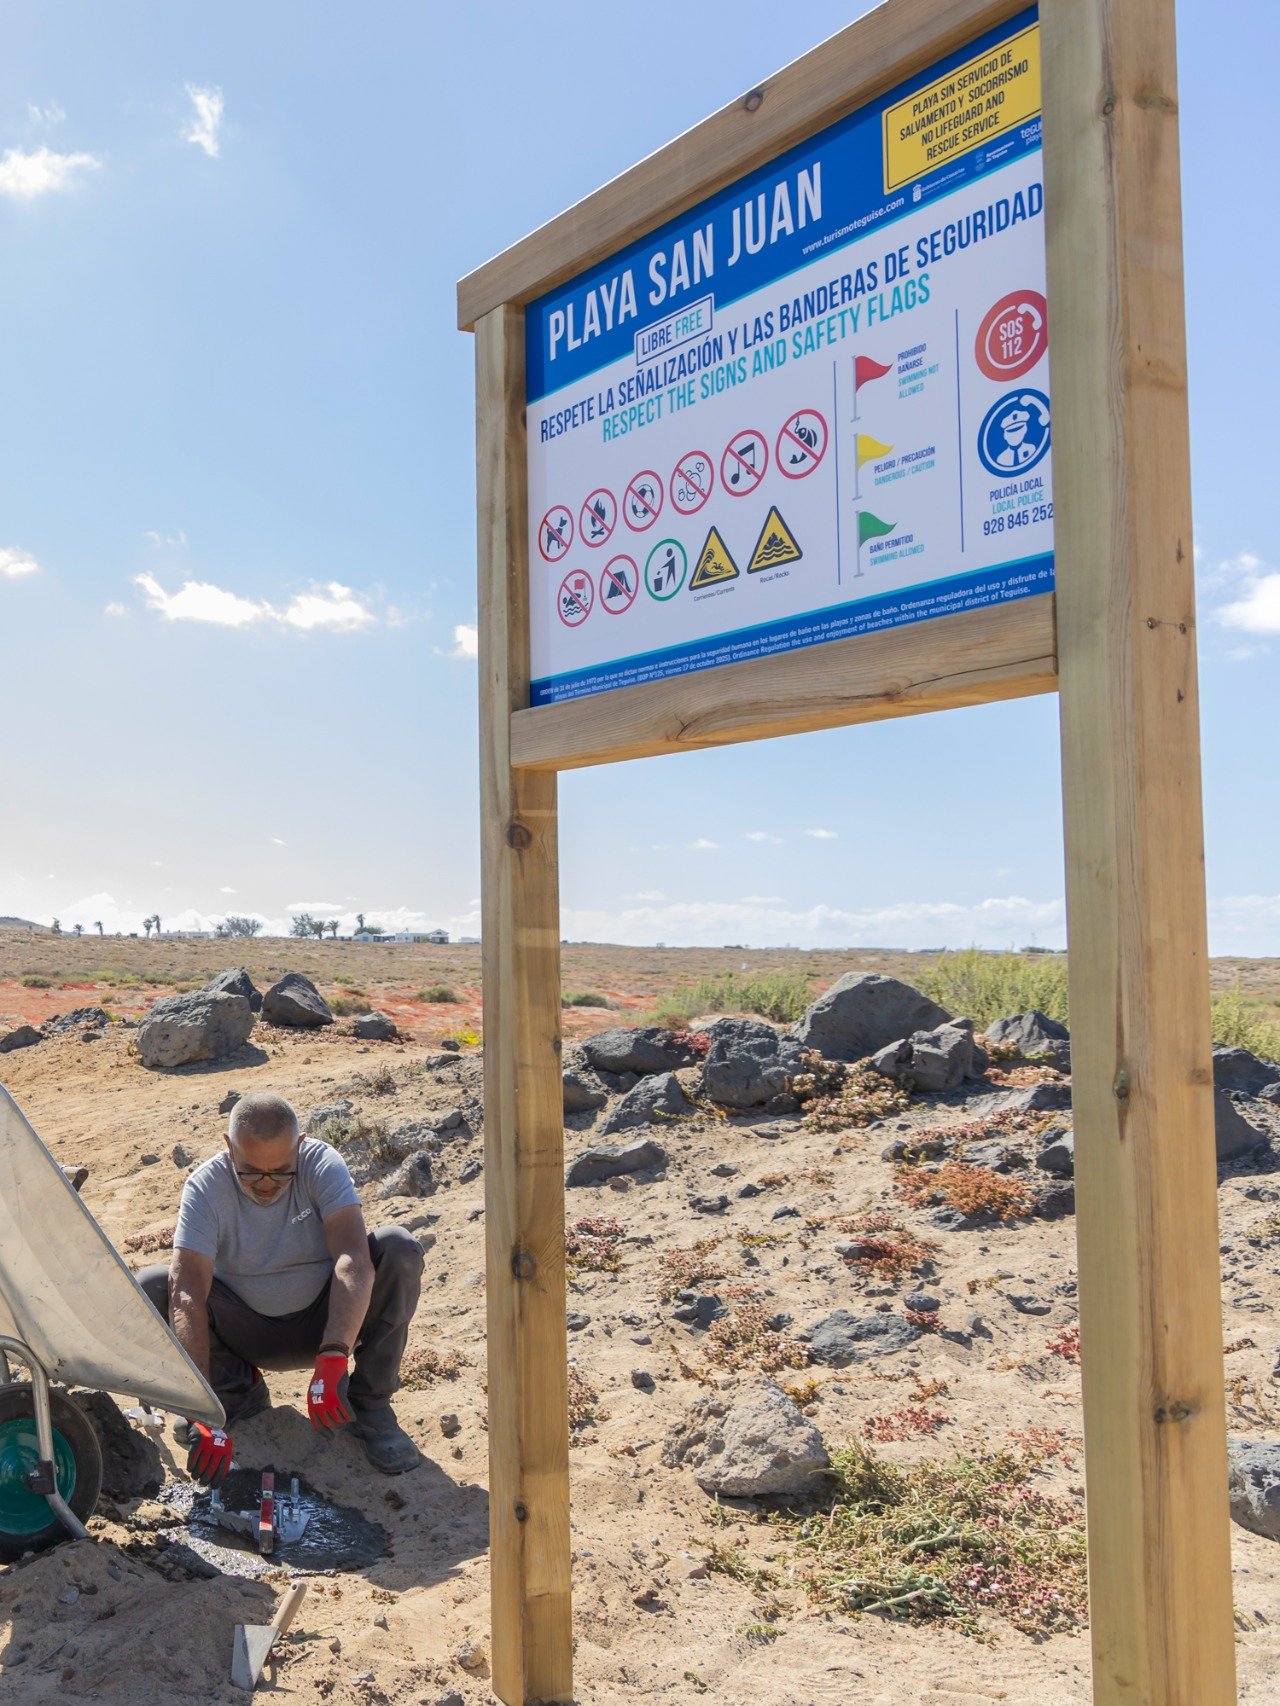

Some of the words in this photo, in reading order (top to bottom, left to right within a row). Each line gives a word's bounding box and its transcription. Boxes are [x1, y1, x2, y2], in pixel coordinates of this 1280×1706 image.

[912, 93, 939, 117] PLAYA
[940, 82, 955, 101] SIN
[957, 58, 998, 91] SERVICIO
[1000, 49, 1013, 68] DE
[900, 102, 956, 141] SALVAMENTO
[958, 95, 965, 109] Y
[968, 59, 1029, 103] SOCORRISMO
[921, 130, 934, 147] NO
[935, 102, 983, 139] LIFEGUARD
[985, 91, 1005, 113] AND
[926, 132, 960, 161] RESCUE
[962, 111, 1000, 142] SERVICE
[801, 197, 905, 256] www.turismoteguise.com
[549, 269, 638, 362] PLAYA
[648, 222, 714, 306] SAN
[728, 161, 822, 267] JUAN
[541, 396, 594, 443] RESPETE
[598, 388, 615, 417] LA
[619, 335, 723, 406] SEÑALIZACIÓN
[728, 327, 739, 355] Y
[743, 311, 774, 350] LAS
[779, 261, 878, 333] BANDERAS
[885, 245, 910, 284] DE
[916, 182, 1043, 269] SEGURIDAD
[642, 324, 672, 356] LIBRE
[675, 308, 703, 340] FREE
[999, 317, 1024, 342] SOS
[603, 393, 664, 443] RESPECT
[667, 379, 696, 414] THE
[700, 356, 747, 400] SIGNS
[752, 338, 787, 378] AND
[792, 302, 862, 360] SAFETY
[867, 272, 931, 328] FLAGS
[898, 343, 927, 362] PROHIBIDO
[1001, 337, 1023, 360] 112
[898, 356, 924, 374] BAÑARSE
[899, 368, 927, 387] SWIMMING
[928, 363, 939, 375] NOT
[898, 382, 925, 399] ALLOWED
[874, 459, 896, 474] PELIGRO
[901, 445, 936, 466] PRECAUCIÓN
[874, 468, 906, 486] DANGEROUS
[911, 459, 935, 474] CAUTION
[989, 480, 1018, 502] POLICÍA
[1019, 476, 1045, 493] LOCAL
[992, 497, 1016, 515] LOCAL
[1018, 489, 1044, 509] POLICE
[983, 515, 1005, 537] 928
[1007, 510, 1029, 531] 845
[1032, 502, 1054, 524] 252
[869, 541, 884, 554] BAÑO
[885, 534, 914, 550] PERMITIDO
[870, 551, 898, 567] SWIMMING
[899, 544, 925, 558] ALLOWED
[706, 645, 730, 658] seguridad
[731, 641, 752, 651] humana
[769, 632, 789, 644] lugares
[790, 629, 797, 637] de
[798, 626, 812, 636] baño
[813, 624, 820, 632] en
[821, 622, 830, 630] las
[830, 618, 849, 629] playas
[850, 617, 854, 625] y
[854, 613, 872, 622] zonas
[900, 597, 935, 611] Ordenanza
[936, 589, 973, 603] reguladora
[974, 584, 986, 594] del
[987, 582, 1000, 591] uso
[1001, 581, 1006, 589] y
[1008, 573, 1037, 586] disfrute
[1038, 569, 1048, 579] de
[732, 648, 760, 660] Ordinance
[760, 641, 791, 653] Regulation
[791, 639, 801, 647] the
[802, 635, 813, 644] use
[814, 632, 825, 641] and
[826, 625, 858, 639] enjoyment
[859, 622, 866, 631] of
[867, 618, 893, 629] beaches
[894, 612, 915, 623] within
[916, 608, 928, 618] the
[929, 602, 963, 615] municipal
[965, 594, 990, 607] district
[991, 591, 999, 601] of
[1000, 586, 1031, 599] Teguise.
